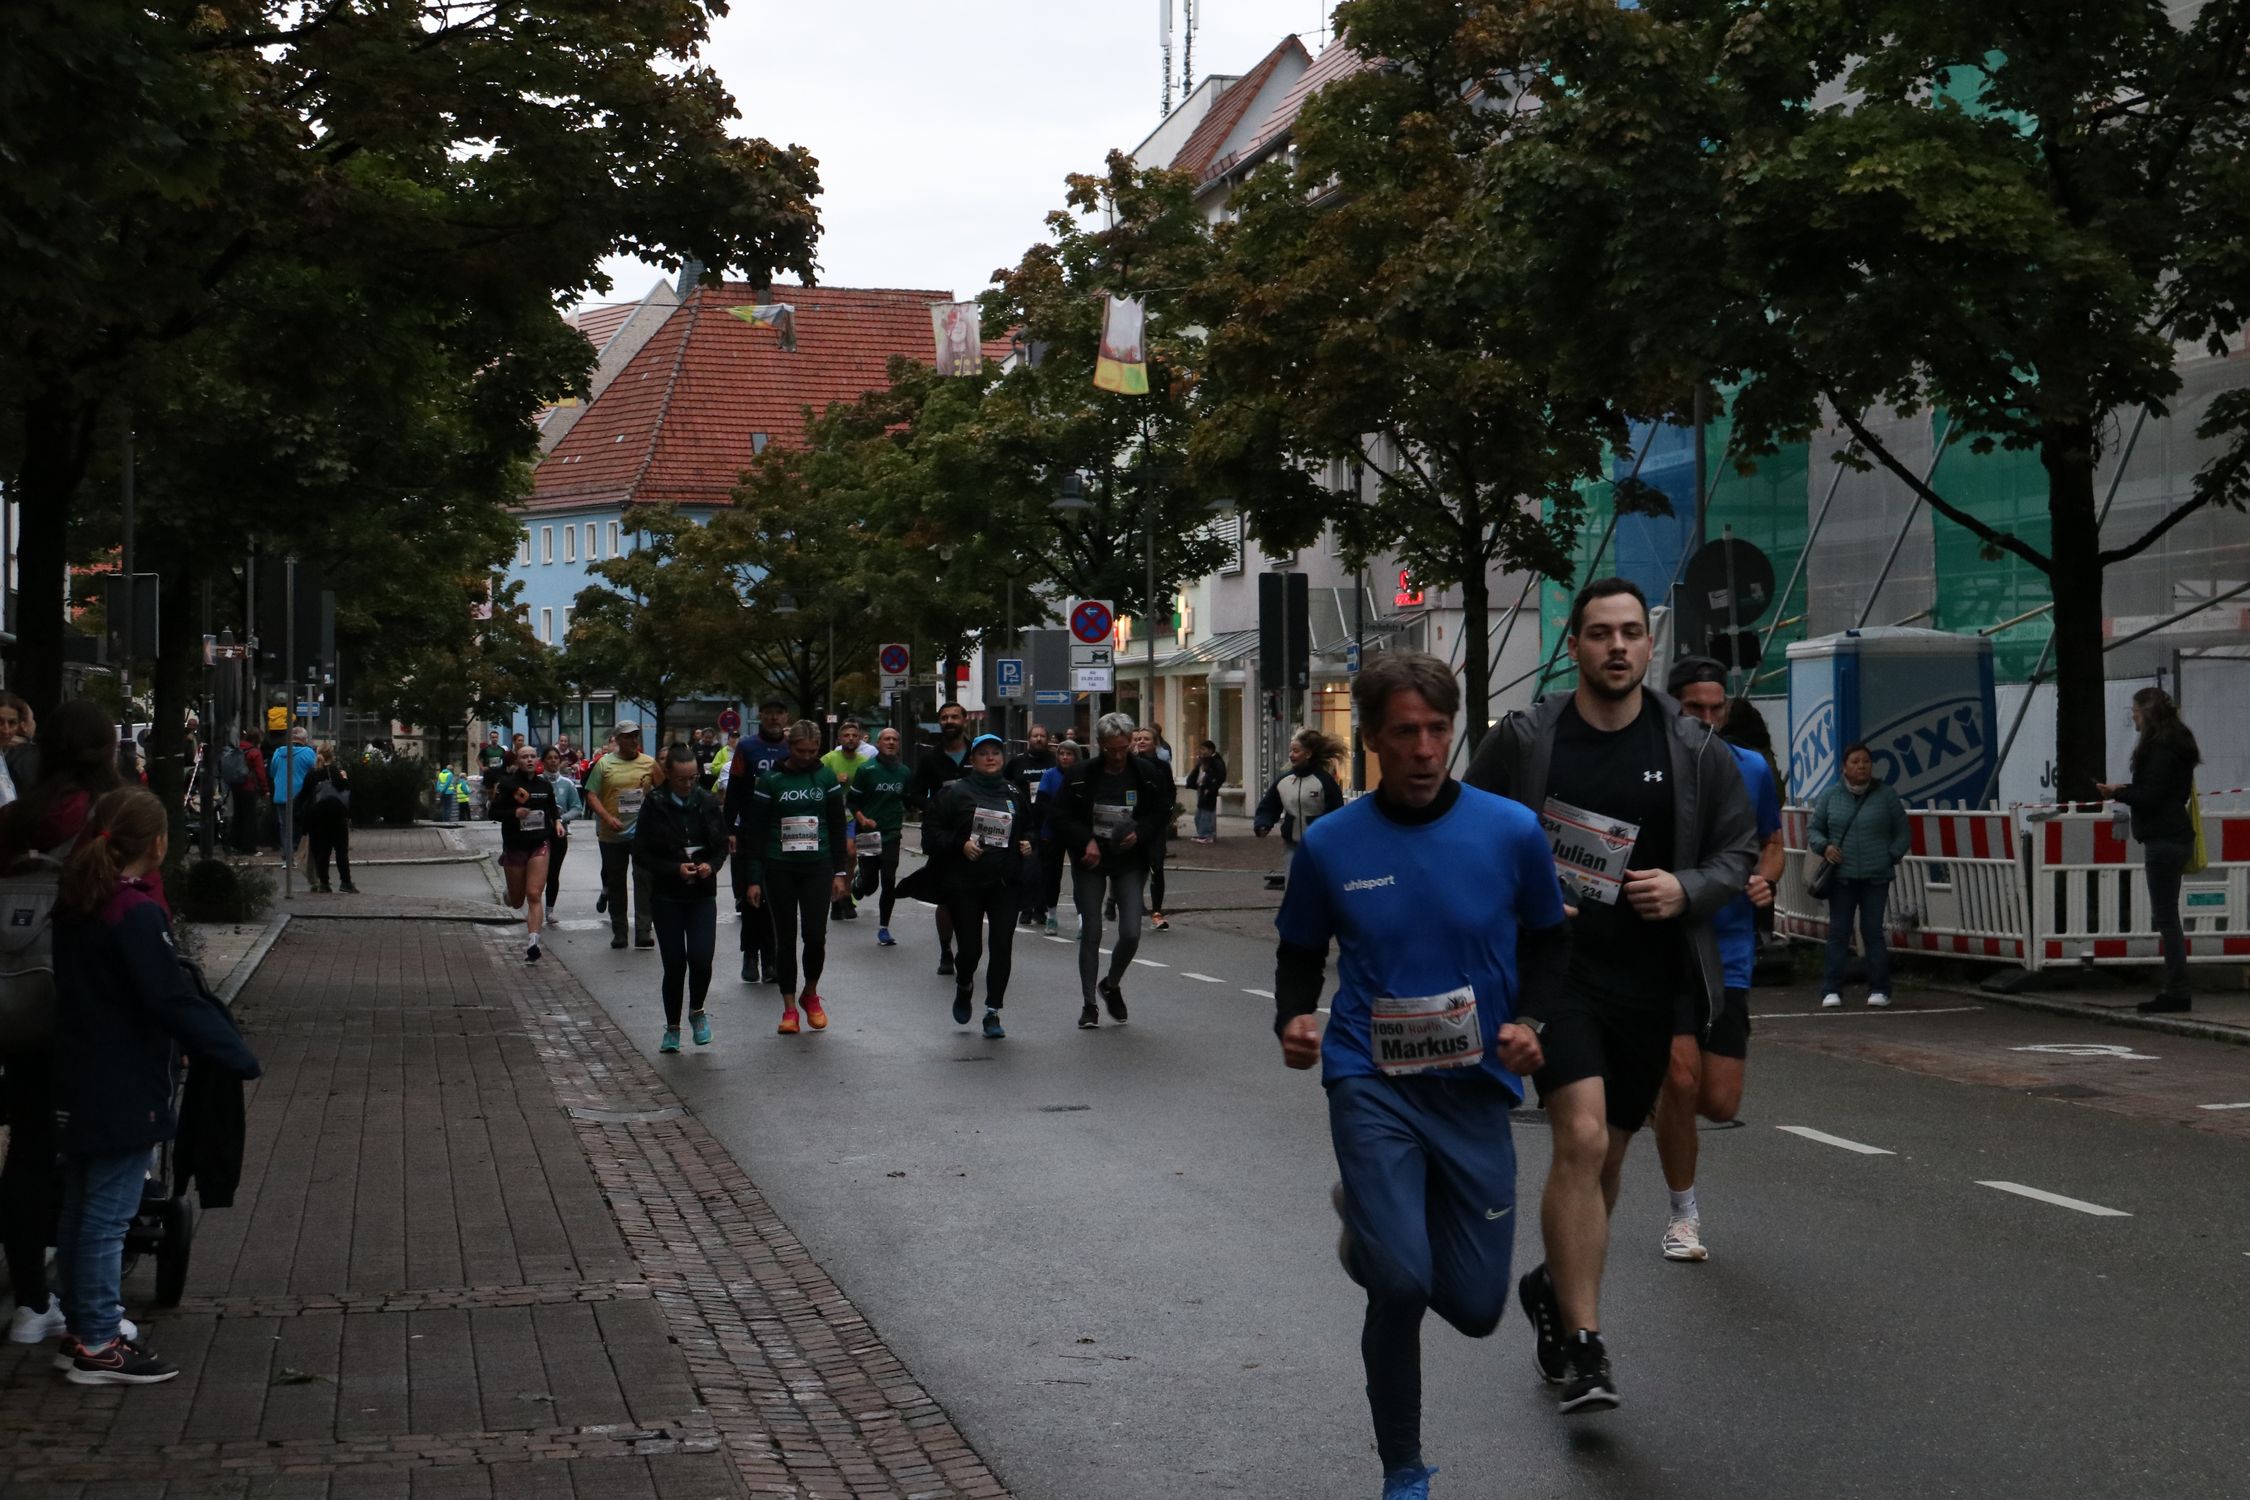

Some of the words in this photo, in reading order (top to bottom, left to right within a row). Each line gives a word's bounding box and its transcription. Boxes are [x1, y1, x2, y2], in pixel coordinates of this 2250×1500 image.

[1003, 663, 1017, 682] P
[875, 783, 895, 791] AOK
[779, 789, 809, 802] AOK
[977, 823, 1005, 835] Regina
[783, 832, 817, 840] Anastasija
[1552, 839, 1607, 872] Julian
[1343, 875, 1396, 892] uhlsport
[1582, 885, 1603, 899] 234
[1374, 1022, 1404, 1035] 1050
[1381, 1034, 1469, 1060] Markus
